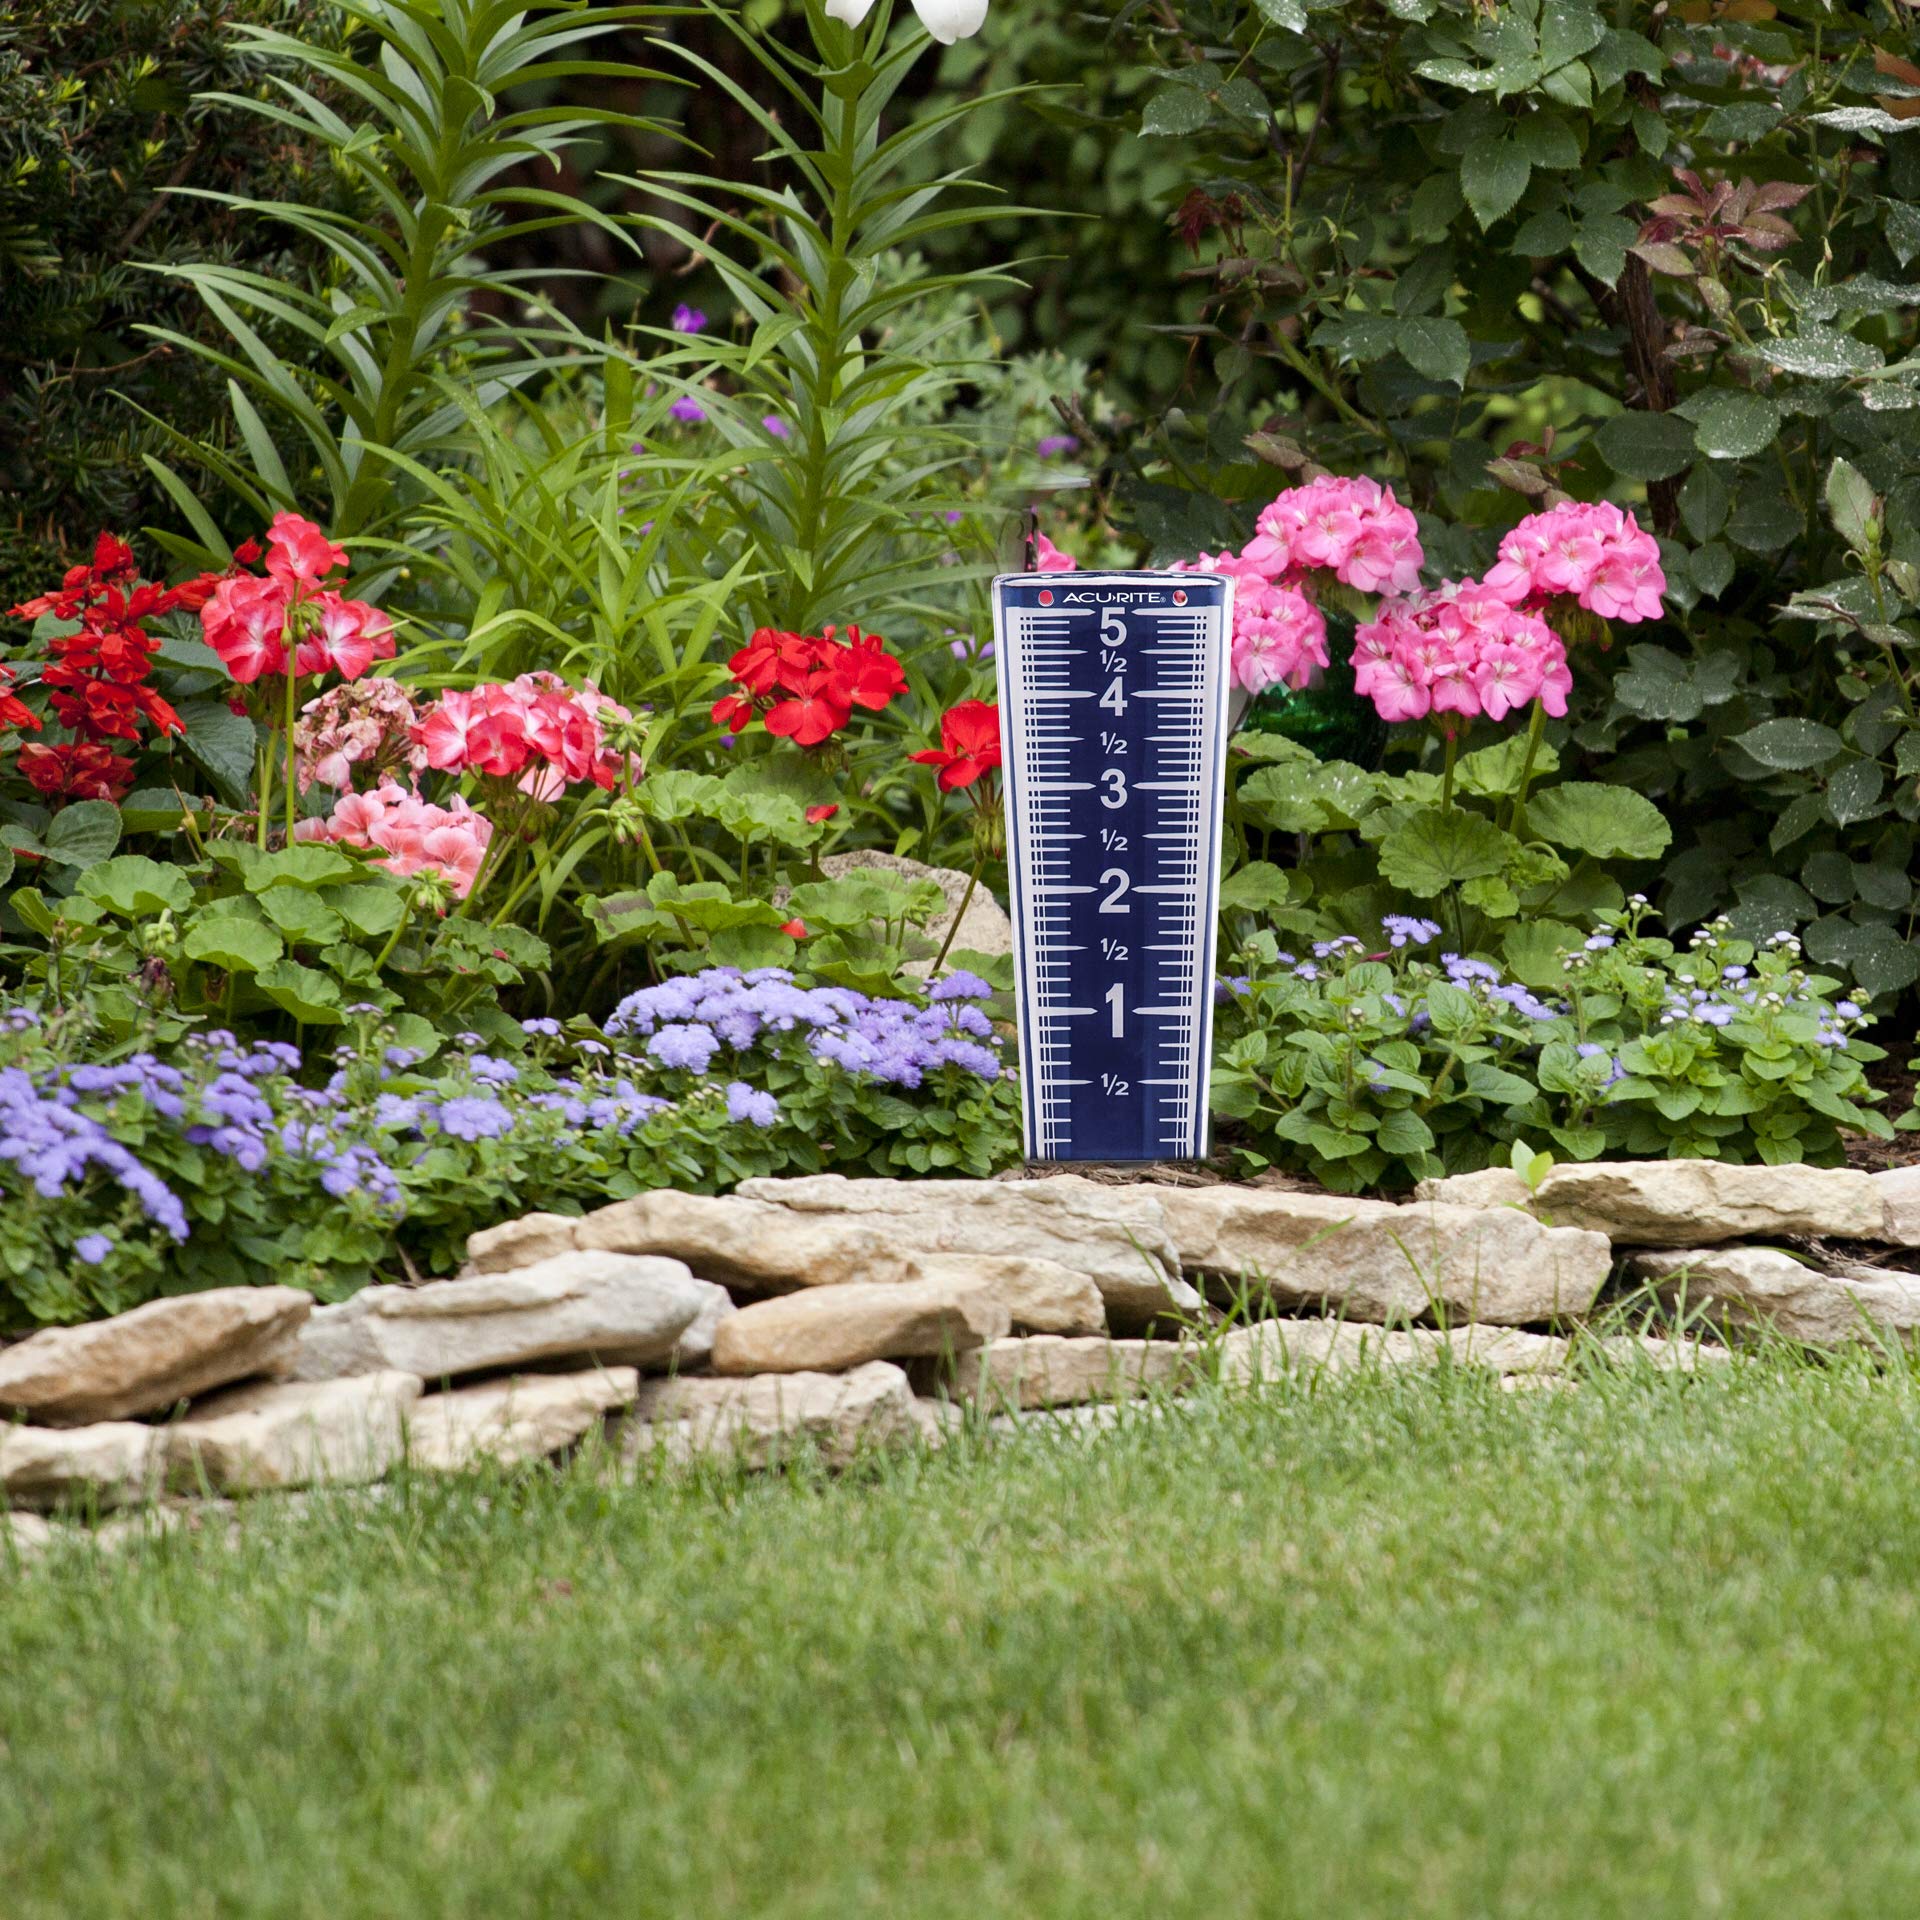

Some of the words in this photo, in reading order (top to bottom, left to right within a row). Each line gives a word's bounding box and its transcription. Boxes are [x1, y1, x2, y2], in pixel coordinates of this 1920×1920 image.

[1100, 607, 1127, 647] 5
[1099, 676, 1128, 717] 4
[1100, 768, 1128, 810] 3
[1098, 867, 1131, 914] 2
[1105, 982, 1124, 1038] 1
